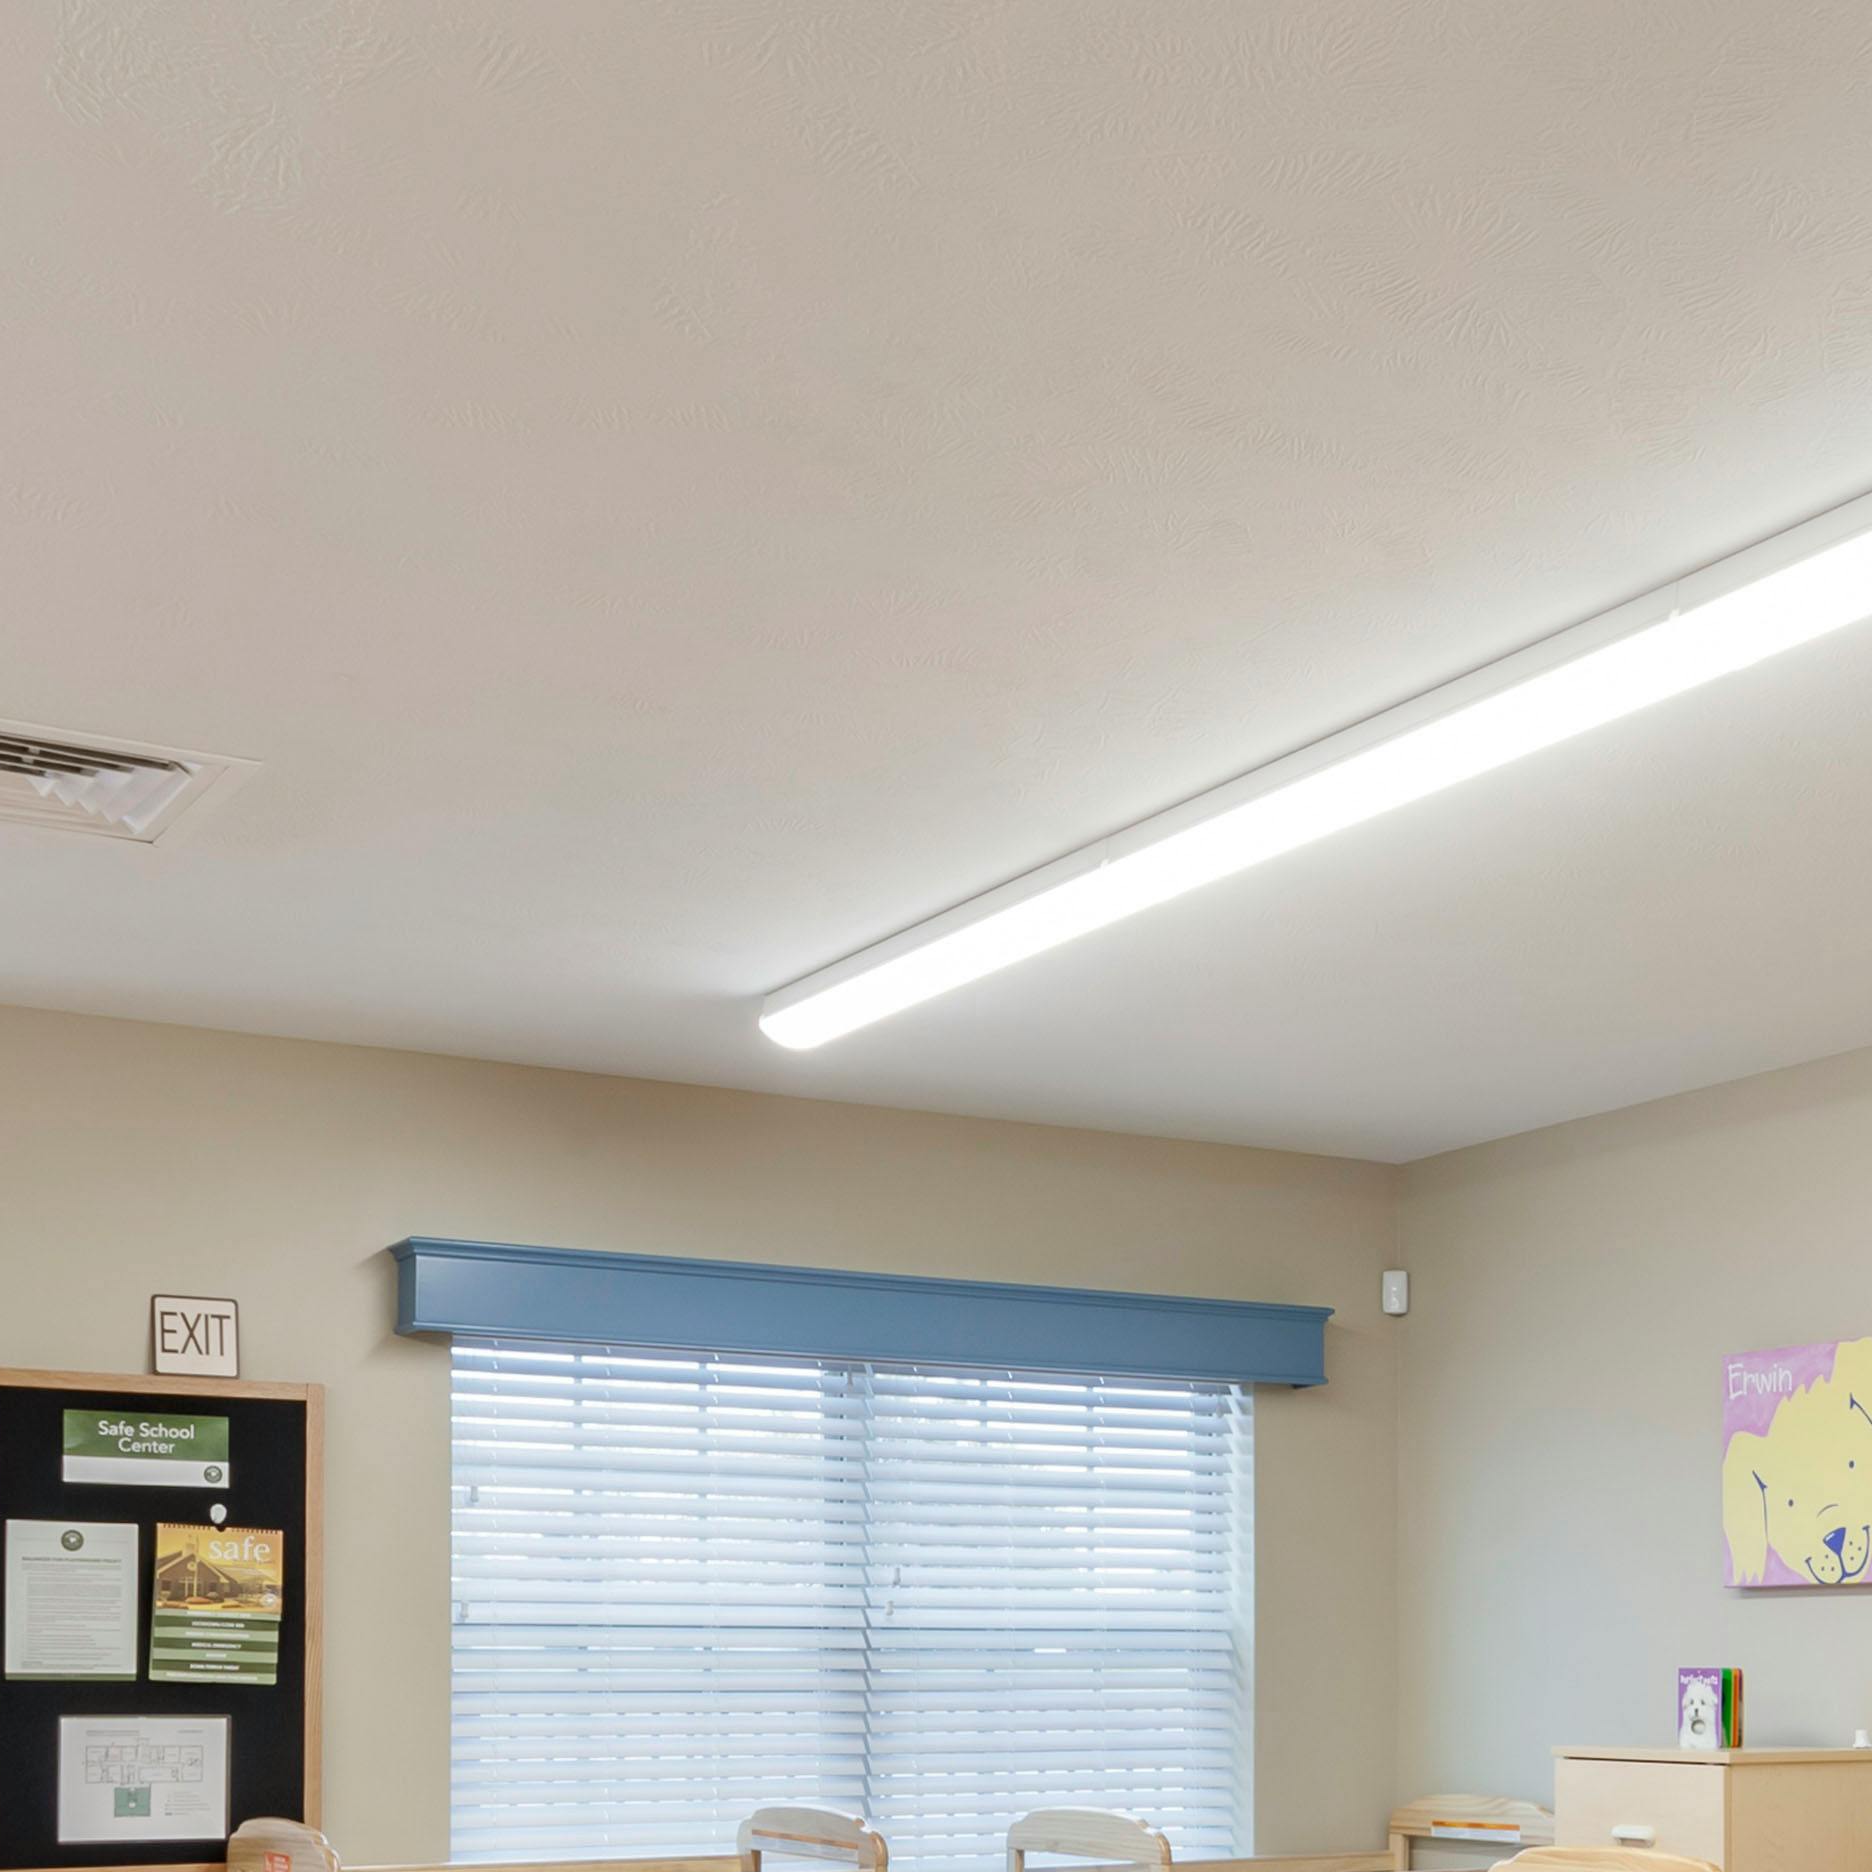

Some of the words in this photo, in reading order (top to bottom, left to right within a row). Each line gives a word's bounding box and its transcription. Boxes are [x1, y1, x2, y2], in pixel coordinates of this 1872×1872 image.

[158, 1310, 231, 1357] EXIT
[1728, 1362, 1793, 1400] Erwin
[98, 1420, 135, 1437] Safe
[139, 1422, 195, 1440] School
[118, 1437, 176, 1454] Center
[208, 1535, 271, 1563] safe
